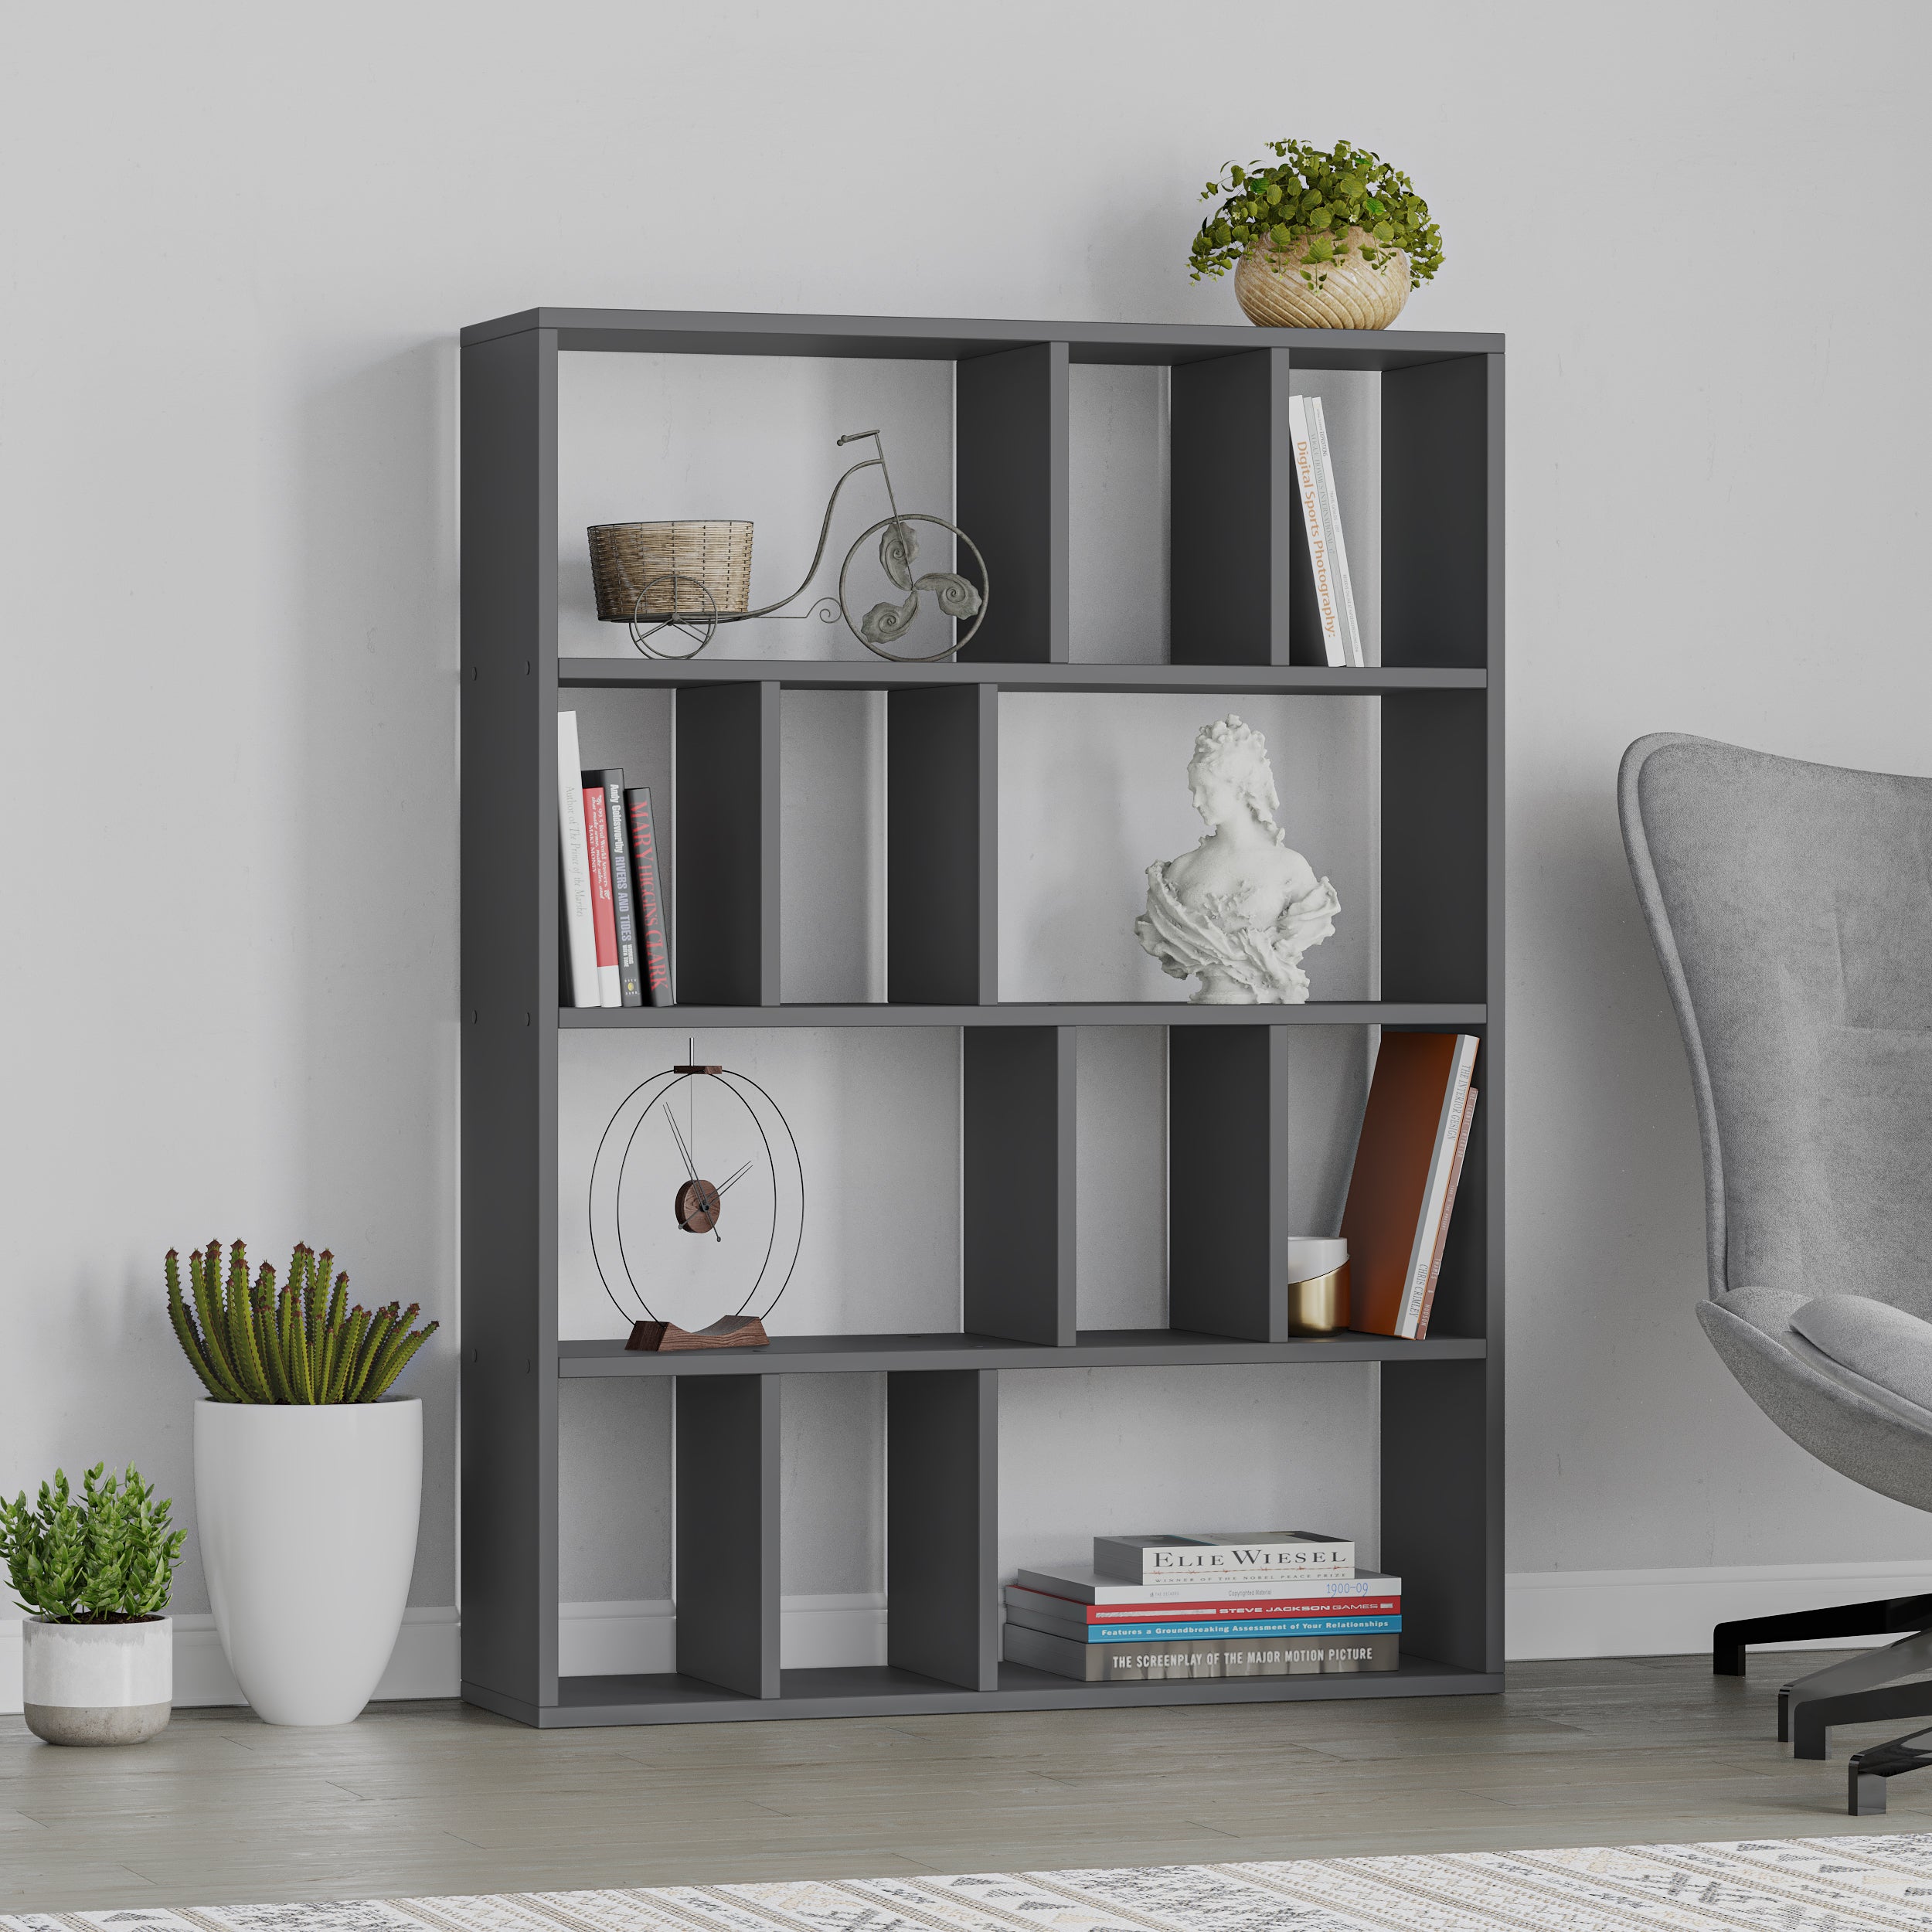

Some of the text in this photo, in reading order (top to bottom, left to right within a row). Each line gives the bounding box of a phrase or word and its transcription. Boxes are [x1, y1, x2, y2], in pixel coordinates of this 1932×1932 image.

[1297, 441, 1314, 488] Digital
[1304, 492, 1319, 537] Sports
[1321, 492, 1333, 544] INTERNATIONAL
[1314, 540, 1335, 638] Photography:
[566, 786, 577, 813] Author
[569, 816, 580, 825] of
[570, 826, 580, 840] The
[570, 843, 581, 865] Prince
[610, 784, 632, 941] Andy Goldsworthy RIVERS AND TIDES
[574, 877, 584, 886] the
[575, 889, 587, 917] Marshes
[629, 801, 668, 991] MARY HIGGINS CLARK
[1460, 1065, 1471, 1080] THE
[1453, 1080, 1469, 1114] INTERIOR
[1464, 1103, 1474, 1126] ICONIC
[1458, 1131, 1468, 1158] INTERIOR
[1441, 1213, 1450, 1231] PRESENT
[1431, 1258, 1440, 1280] THAMES
[1410, 1264, 1428, 1318] CHRIS CRIMLEY
[1421, 1304, 1430, 1326] HUDSON
[1152, 1549, 1347, 1567] ELIE WIESEL
[1326, 1582, 1369, 1598] 1900-09
[1155, 1625, 1230, 1634] Groundbreaking
[1232, 1624, 1287, 1632] Assessment
[1113, 1648, 1372, 1668] THE SCREENPLAY OF THE MAJOR MOTION PICTURE
